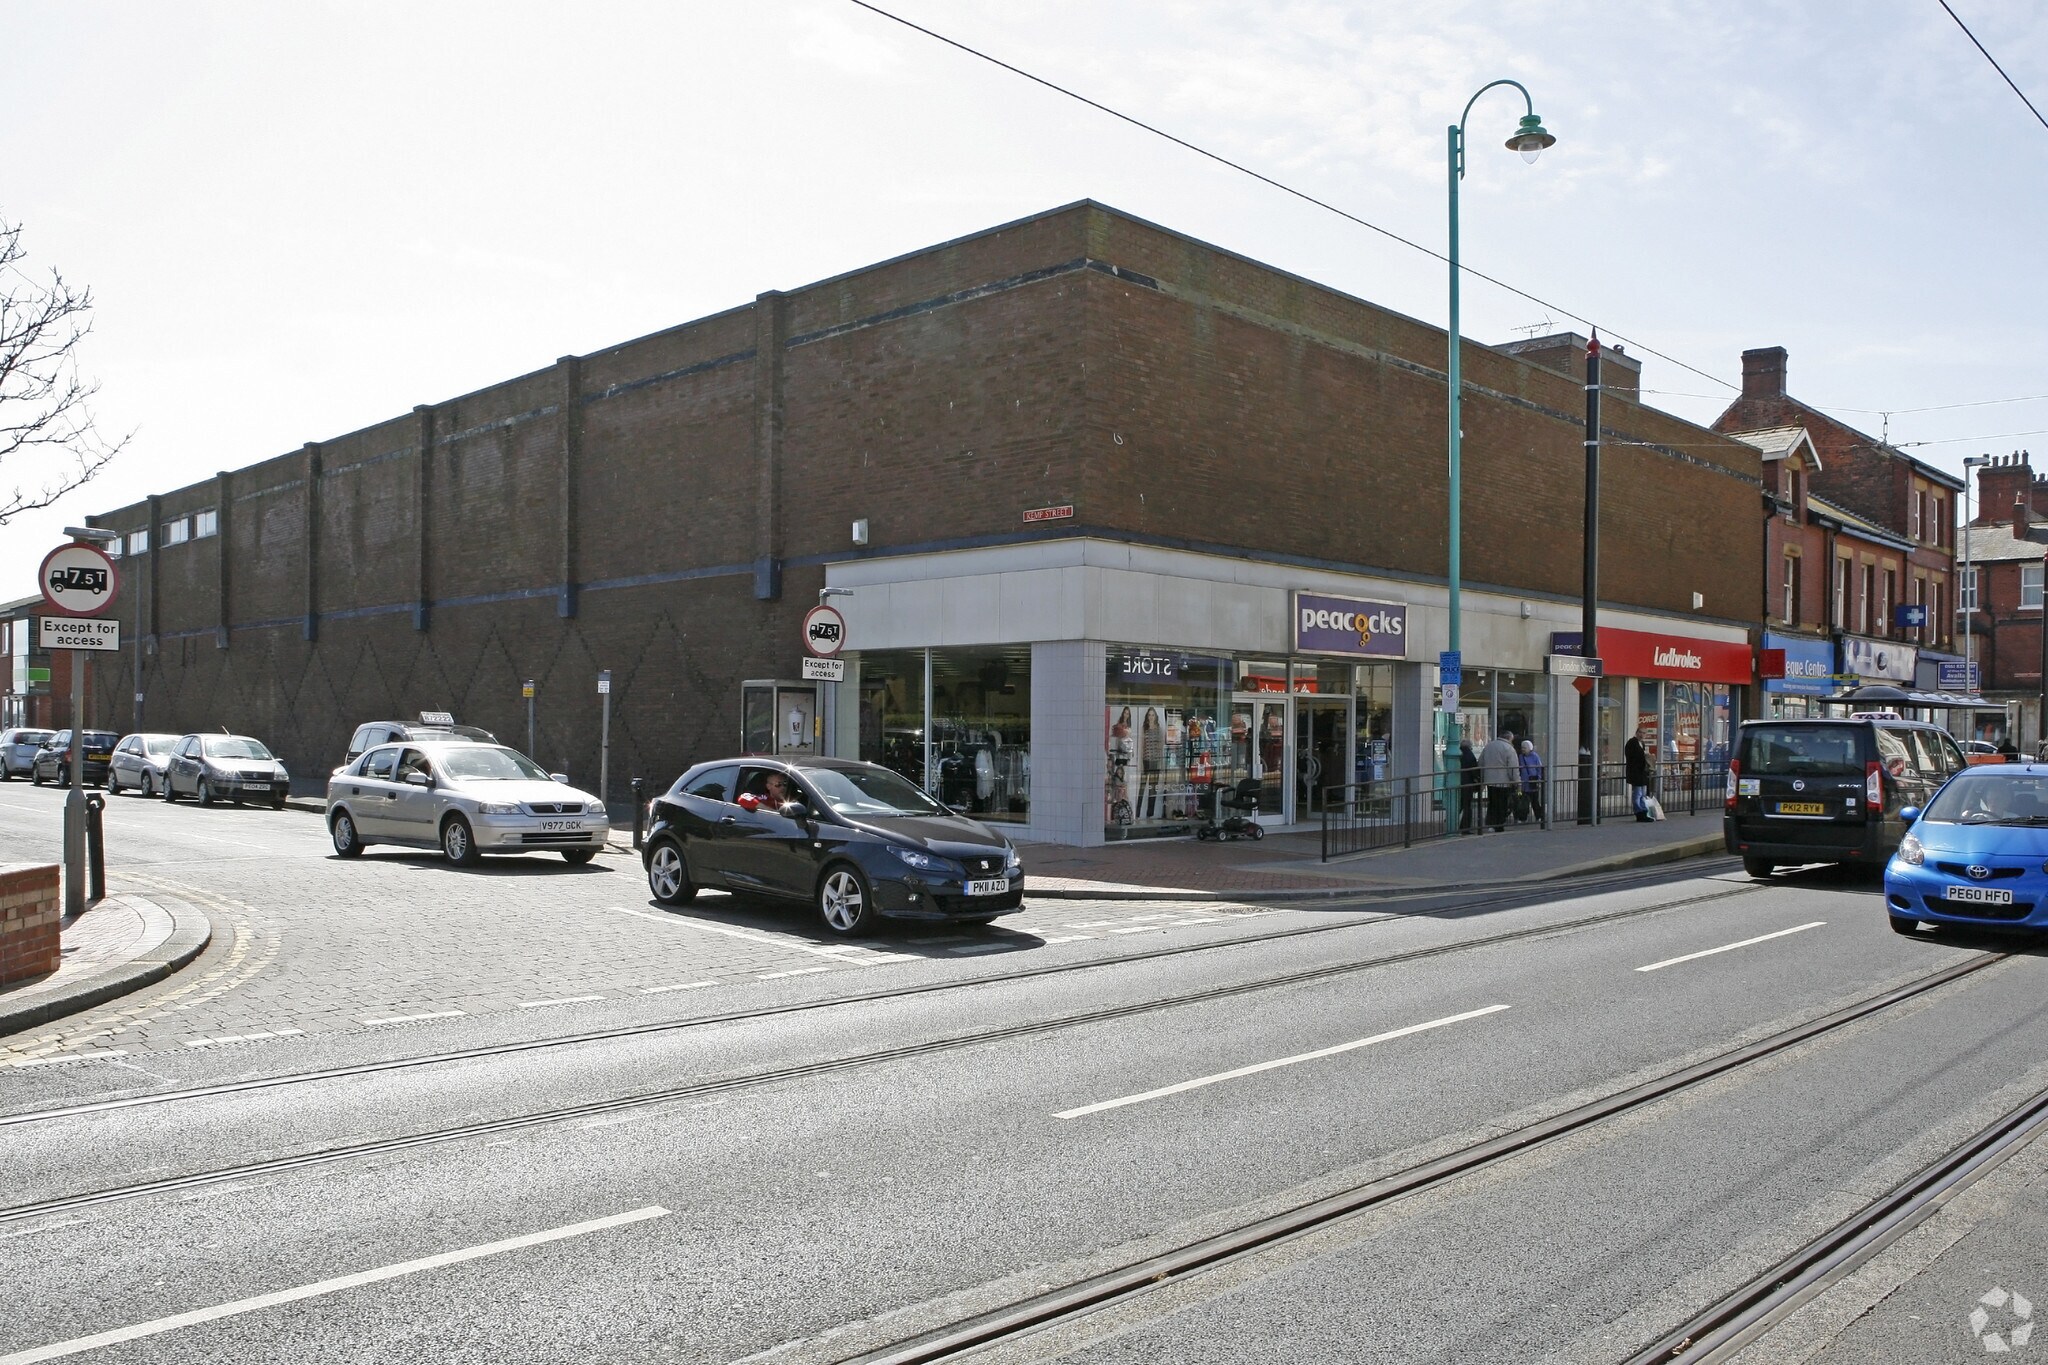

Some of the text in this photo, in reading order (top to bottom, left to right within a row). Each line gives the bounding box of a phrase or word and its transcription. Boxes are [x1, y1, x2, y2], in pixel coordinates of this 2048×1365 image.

[1026, 507, 1068, 520] KEMP STREET
[44, 620, 116, 634] Except for
[1302, 608, 1402, 640] peacocks
[57, 636, 103, 646] access
[1654, 646, 1701, 669] Ladbrokes
[804, 660, 842, 670] Except for
[1559, 660, 1596, 673] London Street
[1785, 659, 1827, 678] eque Centre
[810, 670, 835, 678] access
[1783, 803, 1801, 812] PK12
[542, 821, 582, 830] V977 GCK
[973, 880, 1005, 893] PK11 AZO
[1949, 887, 2010, 902] PE60 HFO
